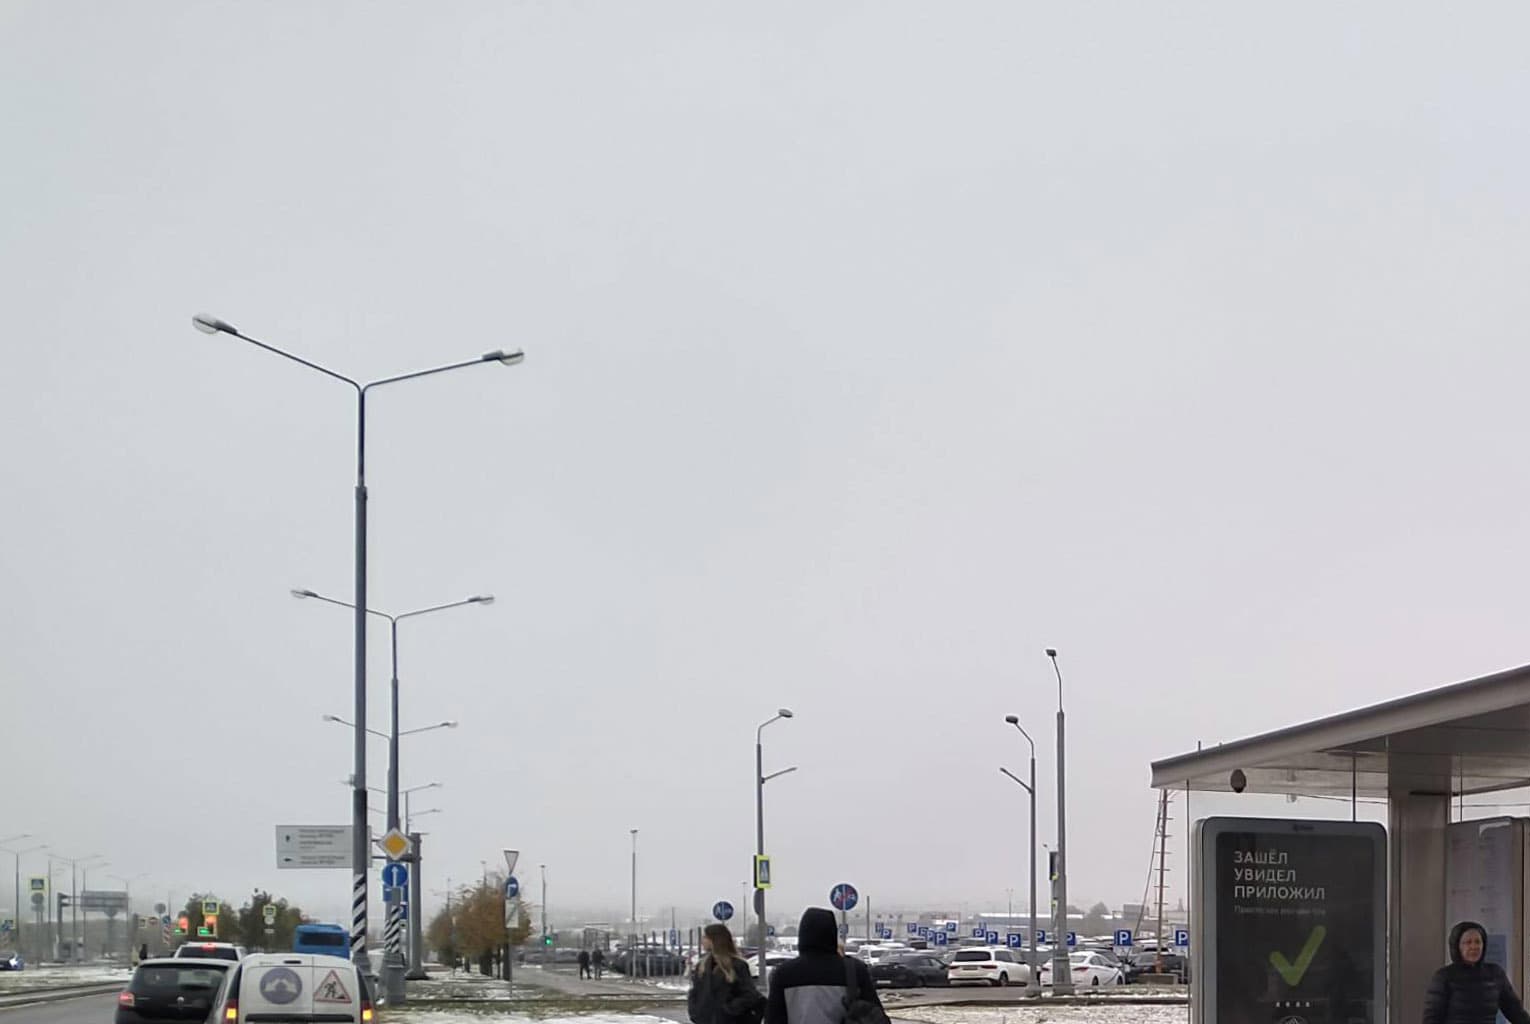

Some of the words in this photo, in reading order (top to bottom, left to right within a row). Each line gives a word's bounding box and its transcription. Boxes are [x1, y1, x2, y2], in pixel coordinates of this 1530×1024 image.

[1234, 848, 1288, 865] ЗАШЁЛ
[1234, 867, 1296, 884] УВИДЕЛ
[1234, 885, 1326, 900] ПРИЛОЖИЛ
